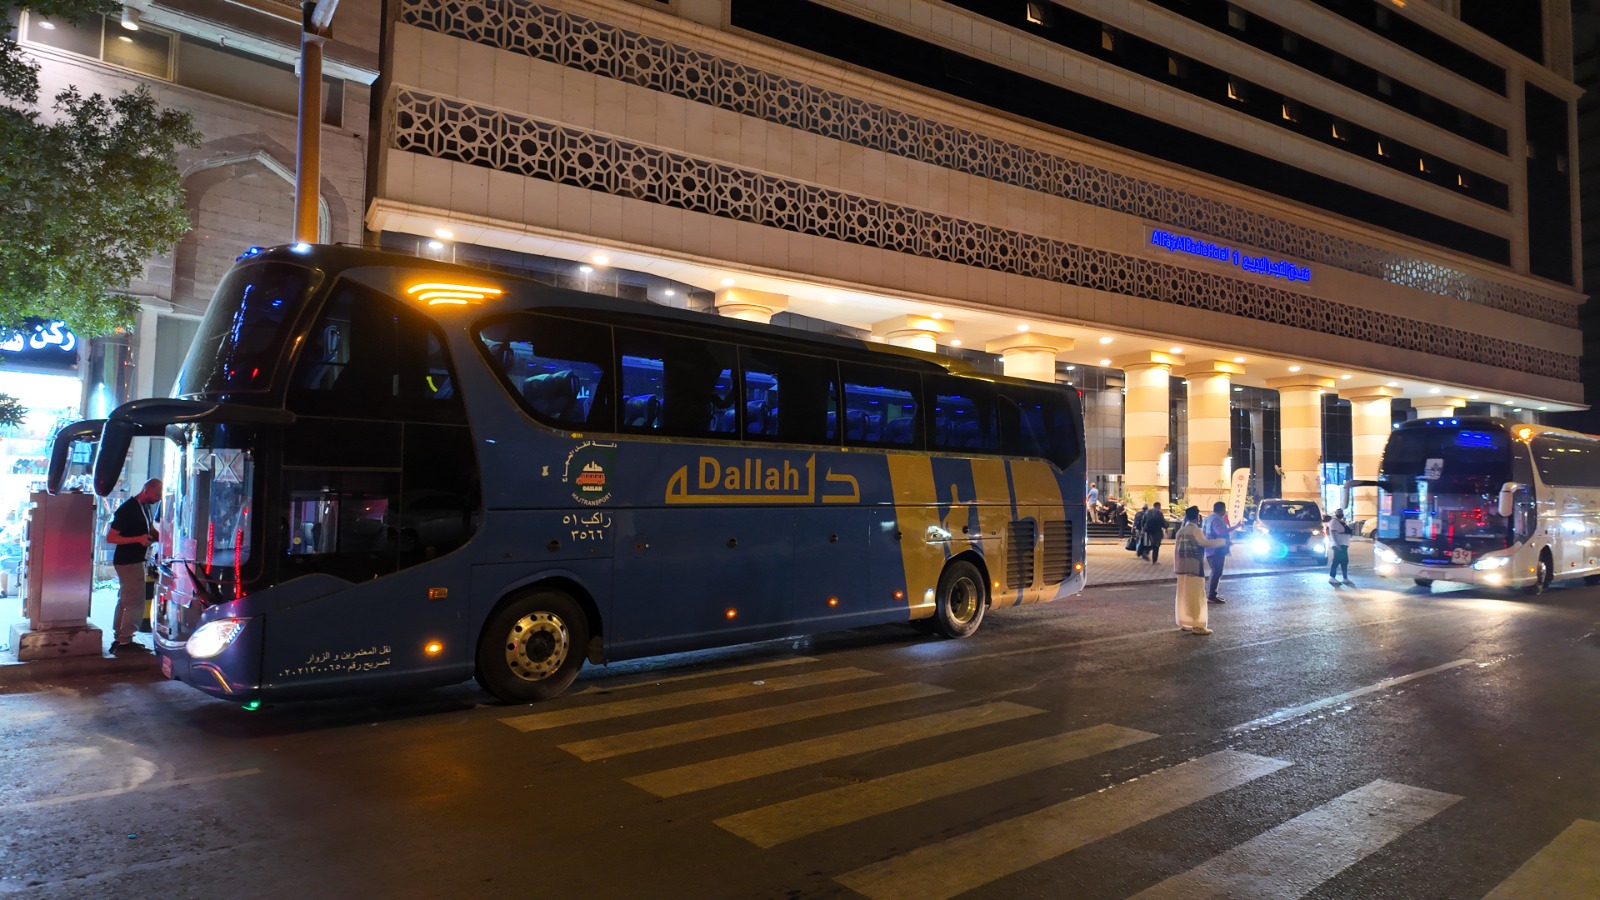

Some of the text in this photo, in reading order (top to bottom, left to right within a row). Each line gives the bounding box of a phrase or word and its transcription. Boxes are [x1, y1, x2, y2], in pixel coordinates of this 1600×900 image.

[1152, 230, 1162, 246] Al
[1162, 232, 1177, 251] Fajr
[1177, 236, 1186, 251] Al
[1186, 239, 1208, 256] Badie
[1208, 243, 1230, 261] Hotel
[1242, 256, 1311, 281] فندق الفجر البديع
[30, 320, 76, 351] ركن
[699, 456, 799, 491] Dallah
[562, 511, 612, 528] راكب ٥١
[571, 529, 604, 541] ٣٥٦٦
[340, 646, 377, 660] المعتمرين
[379, 645, 392, 655] نقل
[306, 651, 331, 664] الزوار
[363, 657, 391, 671] تصريح
[347, 661, 361, 672] رقم
